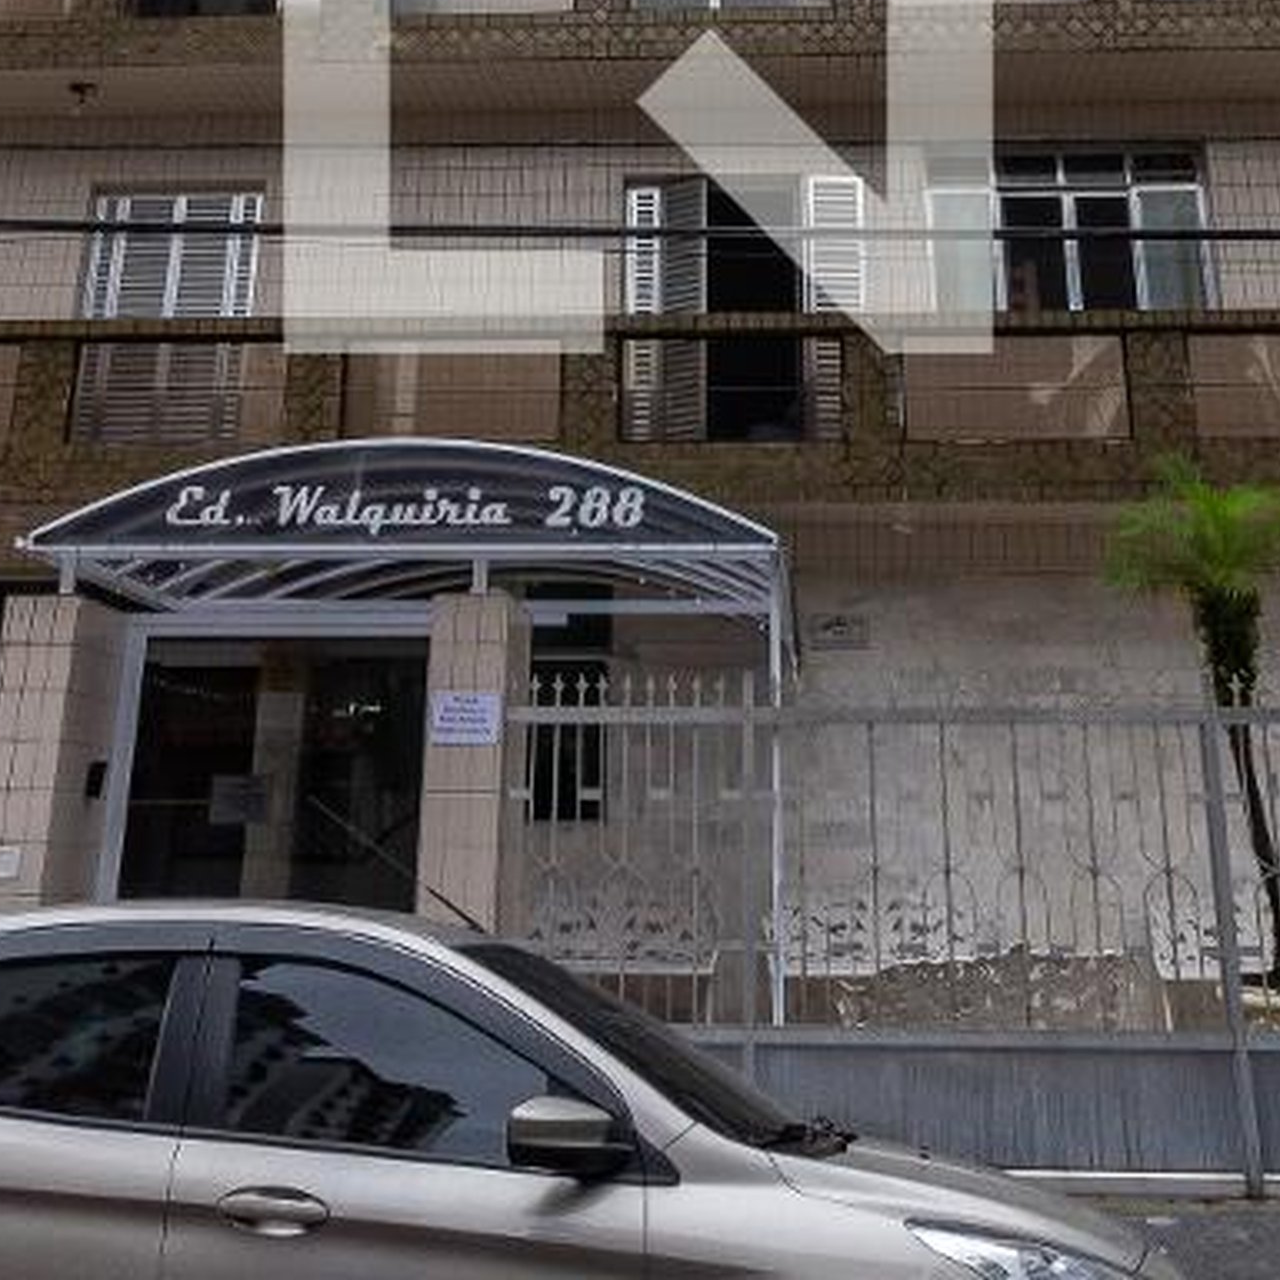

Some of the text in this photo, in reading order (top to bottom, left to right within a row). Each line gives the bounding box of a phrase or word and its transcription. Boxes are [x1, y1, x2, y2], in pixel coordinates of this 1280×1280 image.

[166, 485, 645, 536] Ed. Walquiria 288
